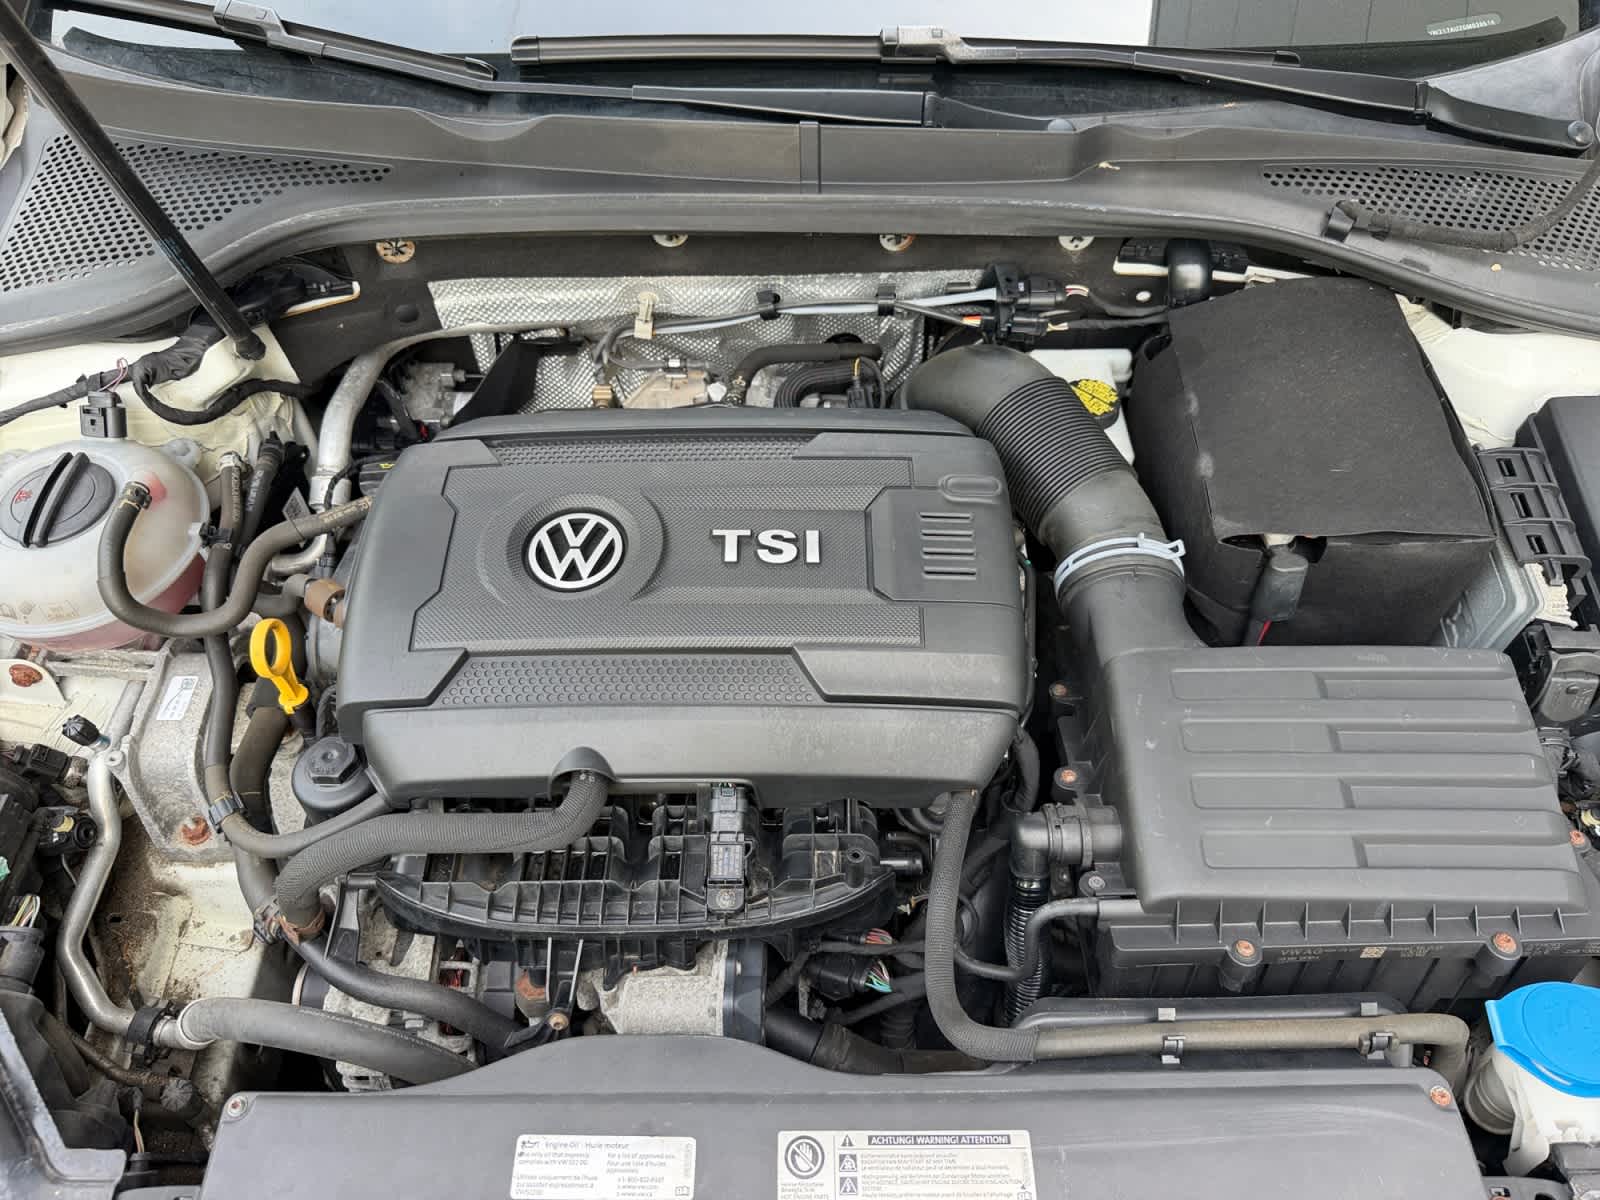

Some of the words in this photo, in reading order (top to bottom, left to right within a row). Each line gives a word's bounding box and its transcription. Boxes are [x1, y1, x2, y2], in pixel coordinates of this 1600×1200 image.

[711, 529, 821, 564] TSI
[870, 1135, 914, 1145] ACHTUNG!
[916, 1135, 959, 1145] WARNING!
[960, 1134, 1009, 1145] ATTENTION!
